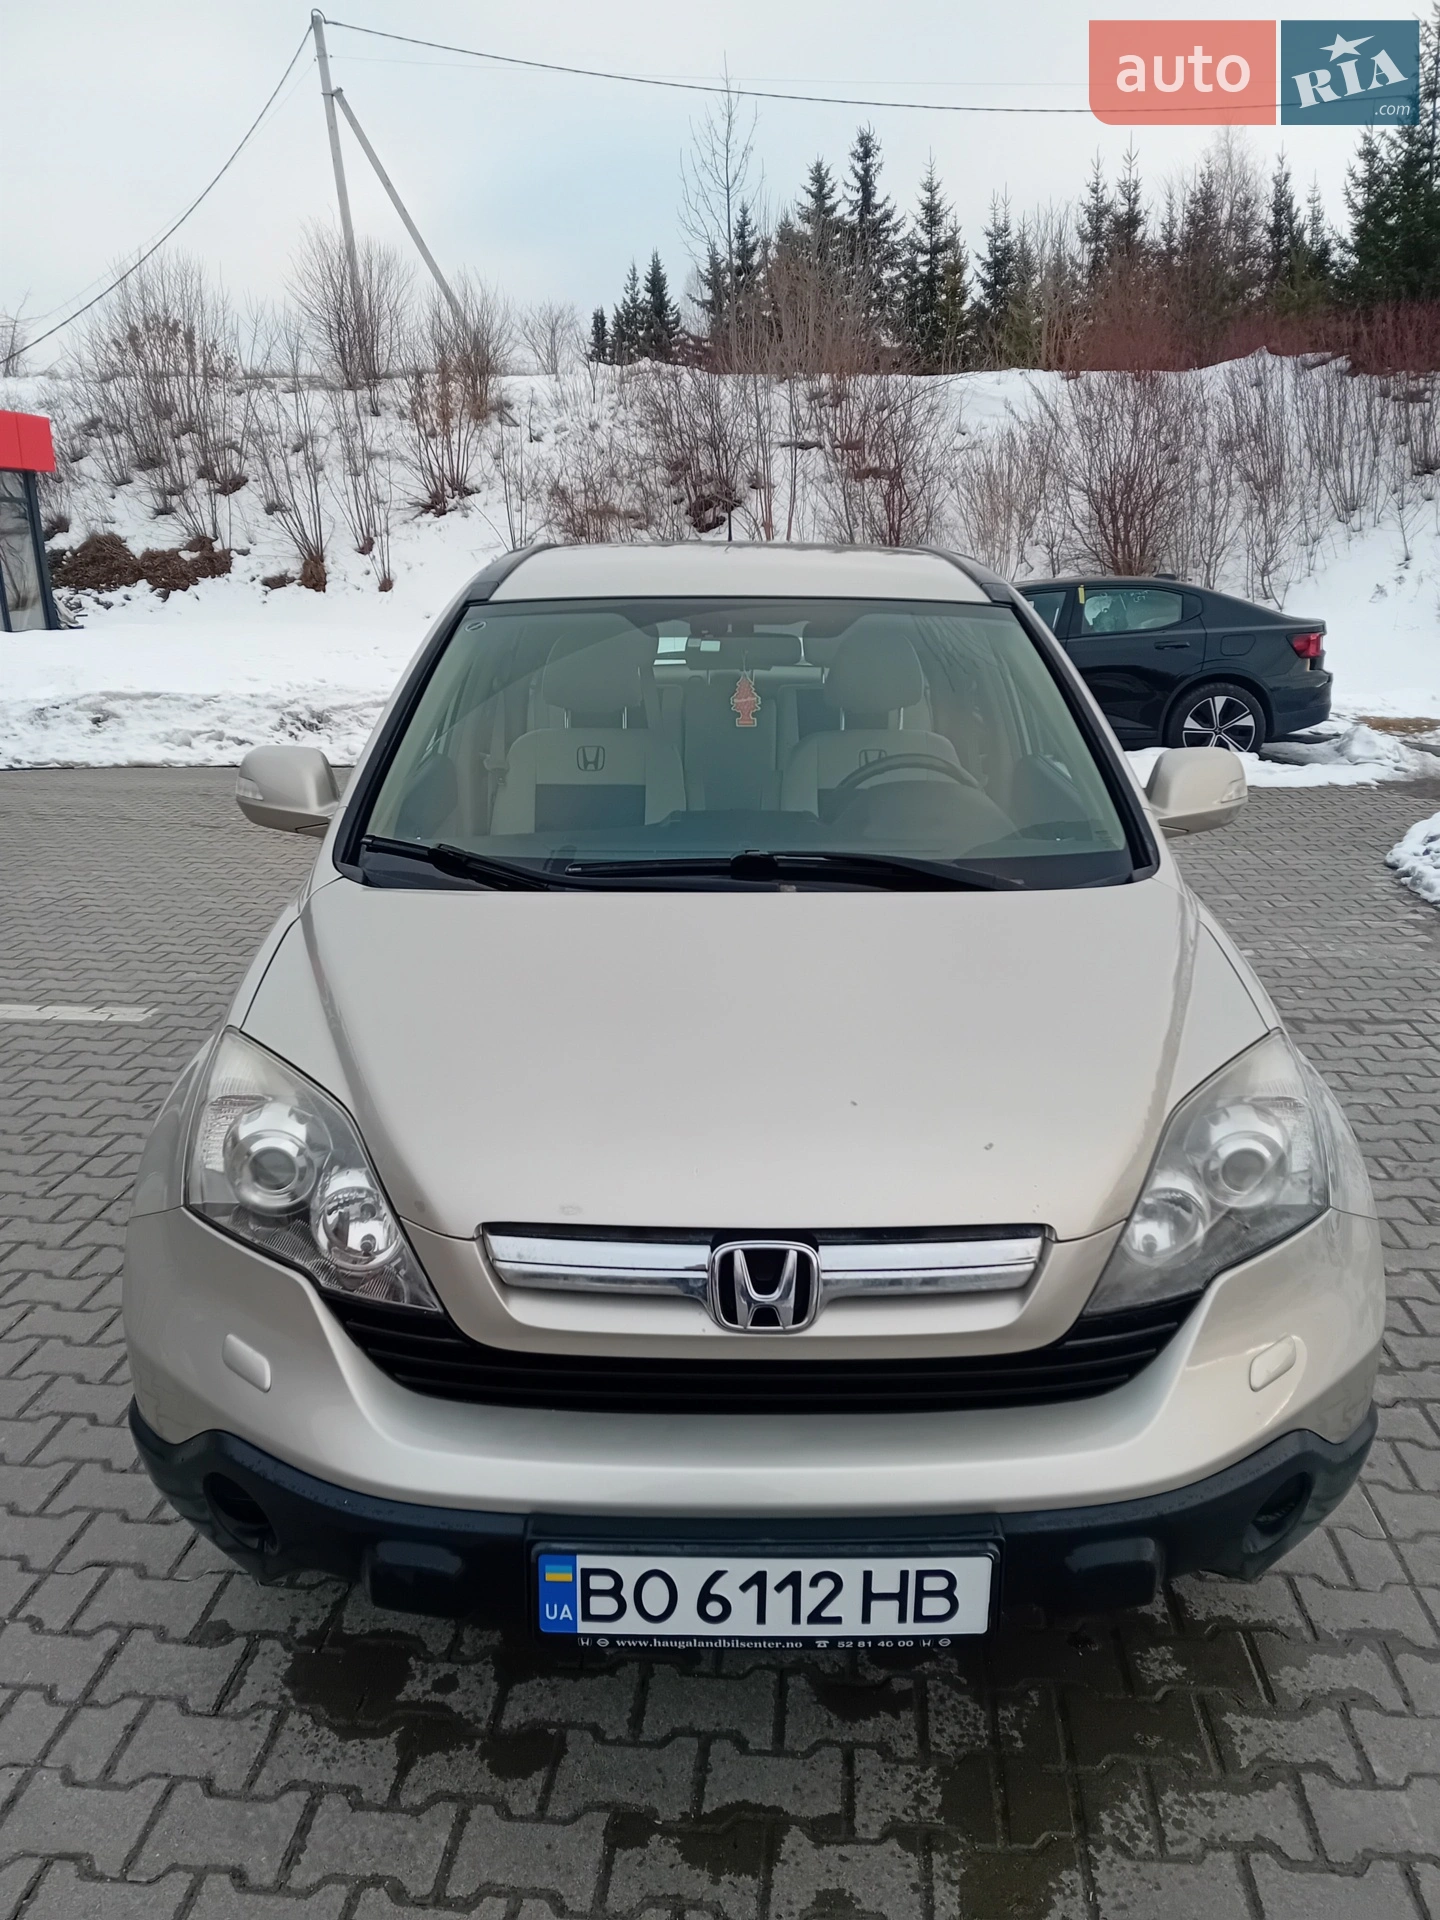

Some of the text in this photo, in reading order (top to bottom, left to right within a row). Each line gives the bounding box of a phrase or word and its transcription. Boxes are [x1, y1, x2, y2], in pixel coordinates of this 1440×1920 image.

[580, 1567, 960, 1626] BO 6112 HB
[545, 1603, 573, 1621] UA
[615, 1638, 803, 1649] www.haugalandbilsenter.no
[837, 1640, 853, 1648] 52
[857, 1640, 872, 1648] 81
[897, 1639, 914, 1647] 00
